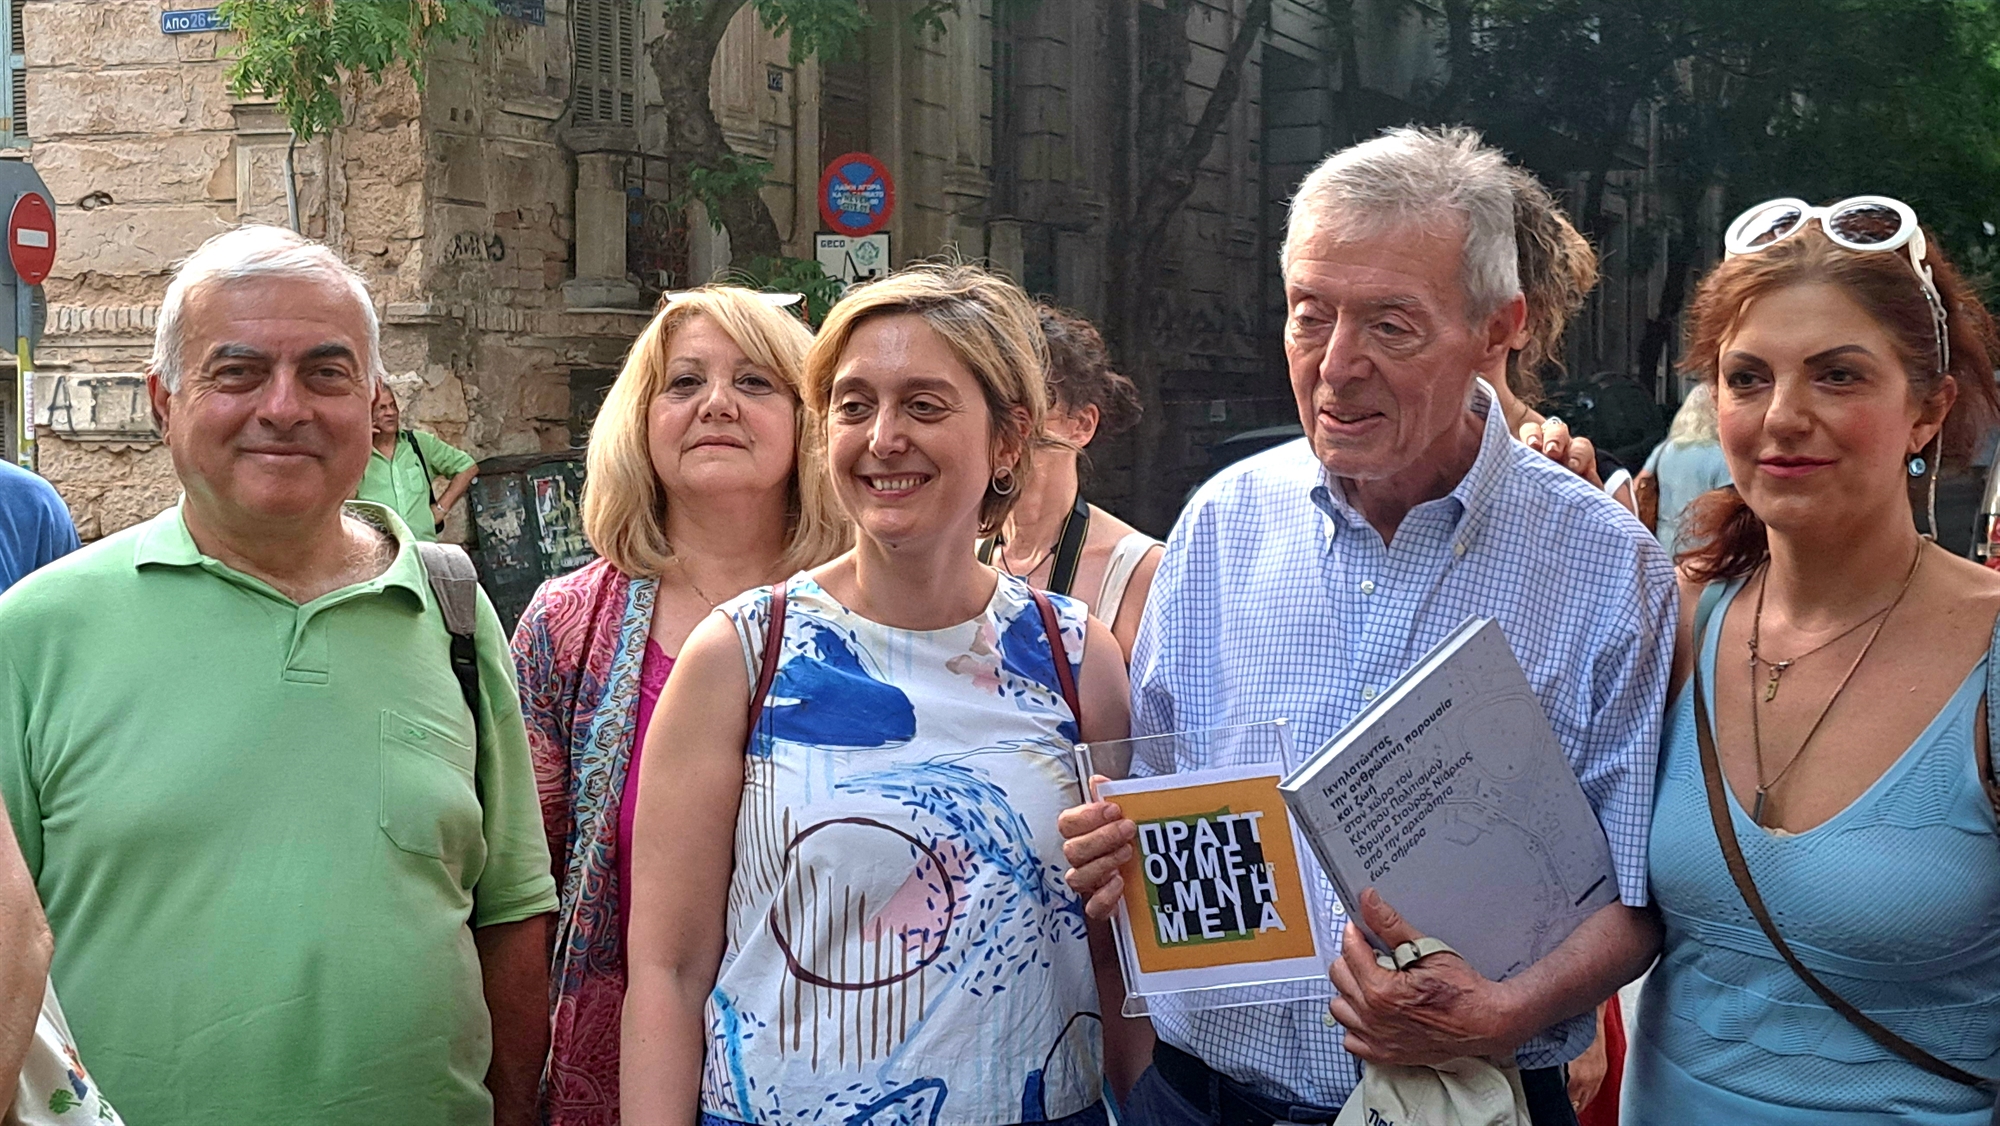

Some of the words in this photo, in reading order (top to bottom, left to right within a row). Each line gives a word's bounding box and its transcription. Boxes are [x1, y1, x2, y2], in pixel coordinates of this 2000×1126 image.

[165, 18, 189, 30] ΑΠΟ
[190, 13, 206, 28] 26
[1322, 735, 1393, 798] Ιχνηλατώντας
[1330, 793, 1348, 810] την
[1350, 741, 1405, 793] ανθρώπινη
[1404, 698, 1453, 744] παρουσία
[1337, 805, 1354, 822] και
[1354, 784, 1377, 808] ζωή
[1344, 811, 1367, 834] στον
[1368, 787, 1395, 813] χώρο
[1396, 769, 1413, 787] του
[1349, 808, 1390, 846] Κέντρου
[1390, 758, 1444, 810] Πολιτισμού
[1354, 824, 1392, 858] Ίδρυμα
[1392, 787, 1433, 826] Σταύρος
[1432, 751, 1474, 788] Νιάρχος
[1363, 851, 1383, 870] από
[1384, 832, 1401, 852] την
[1402, 785, 1454, 836] αρχαιότητα
[1144, 845, 1246, 885] ΟΥΜΕ
[1370, 861, 1391, 882] έως
[1391, 827, 1427, 864] σήμερα
[1173, 872, 1278, 911] ΜΝΗ
[1155, 901, 1286, 943] ΜΕΙΑ
